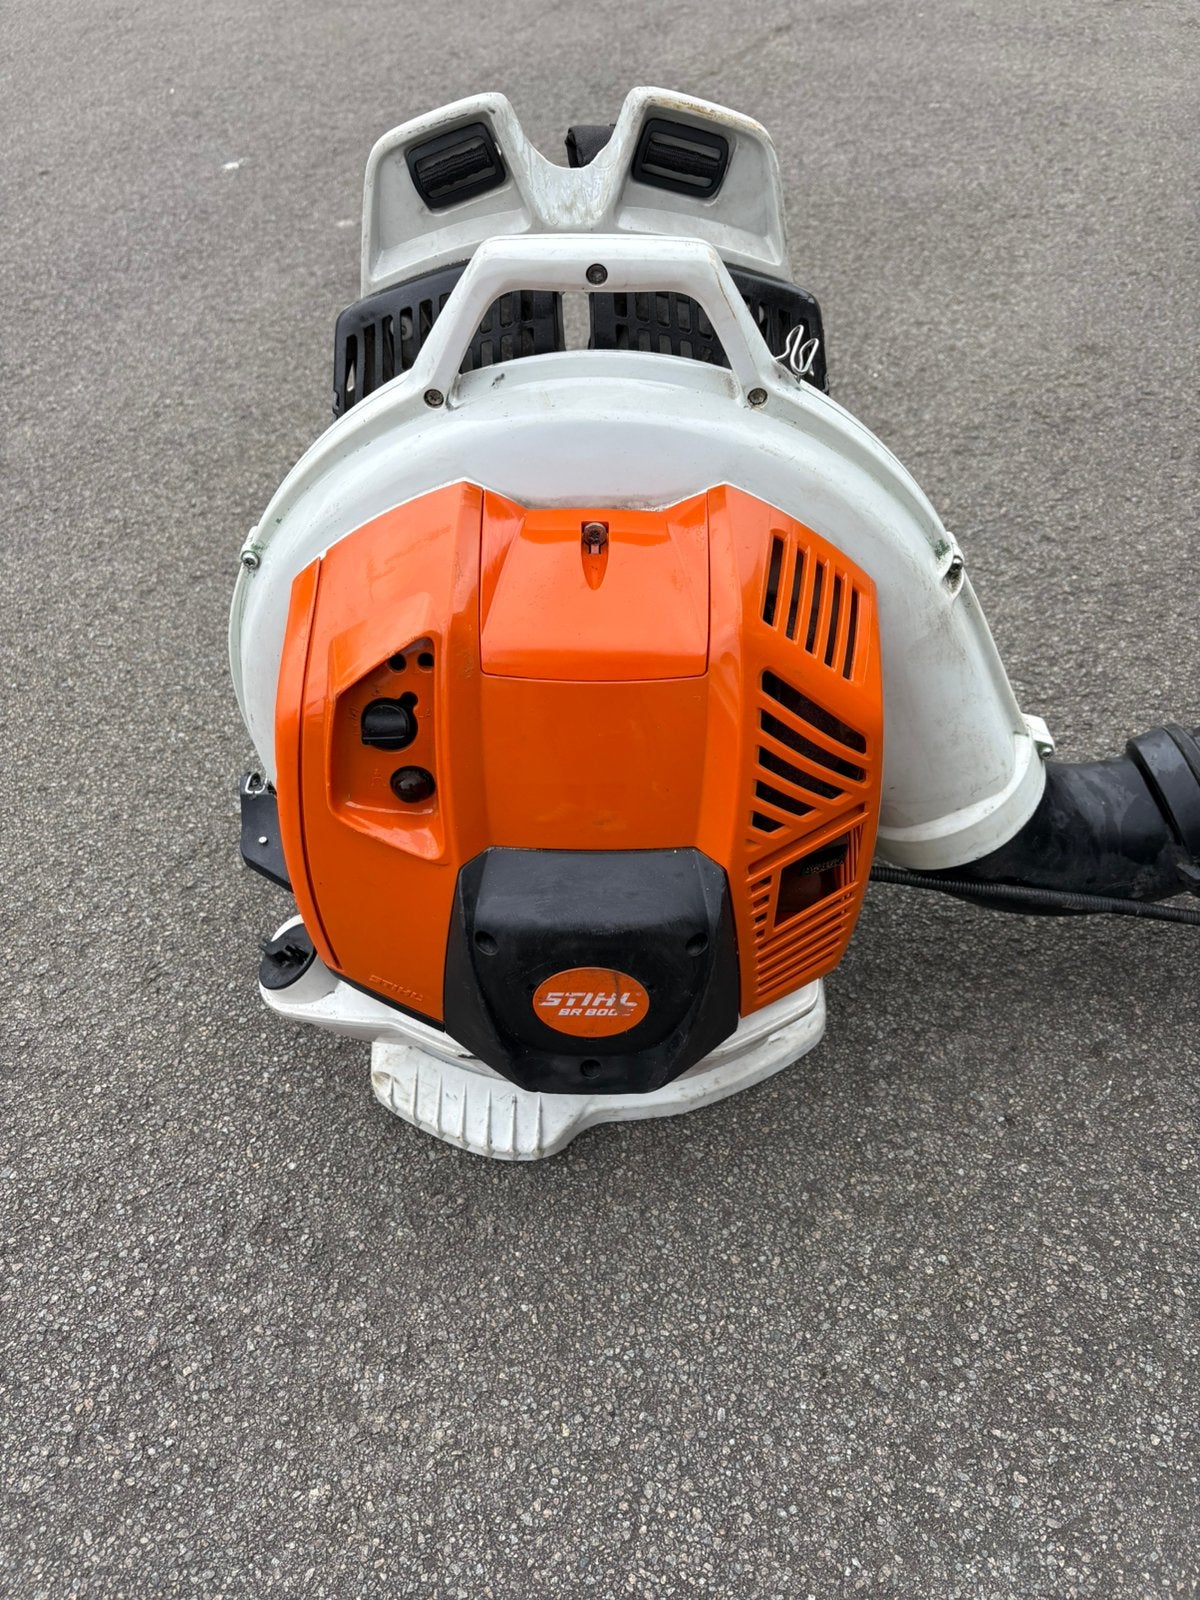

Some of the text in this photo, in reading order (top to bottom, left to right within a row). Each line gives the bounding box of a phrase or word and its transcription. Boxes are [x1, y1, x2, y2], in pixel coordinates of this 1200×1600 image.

[368, 974, 424, 1002] STIHL
[538, 992, 638, 1007] STIHL
[557, 1008, 583, 1016] BR
